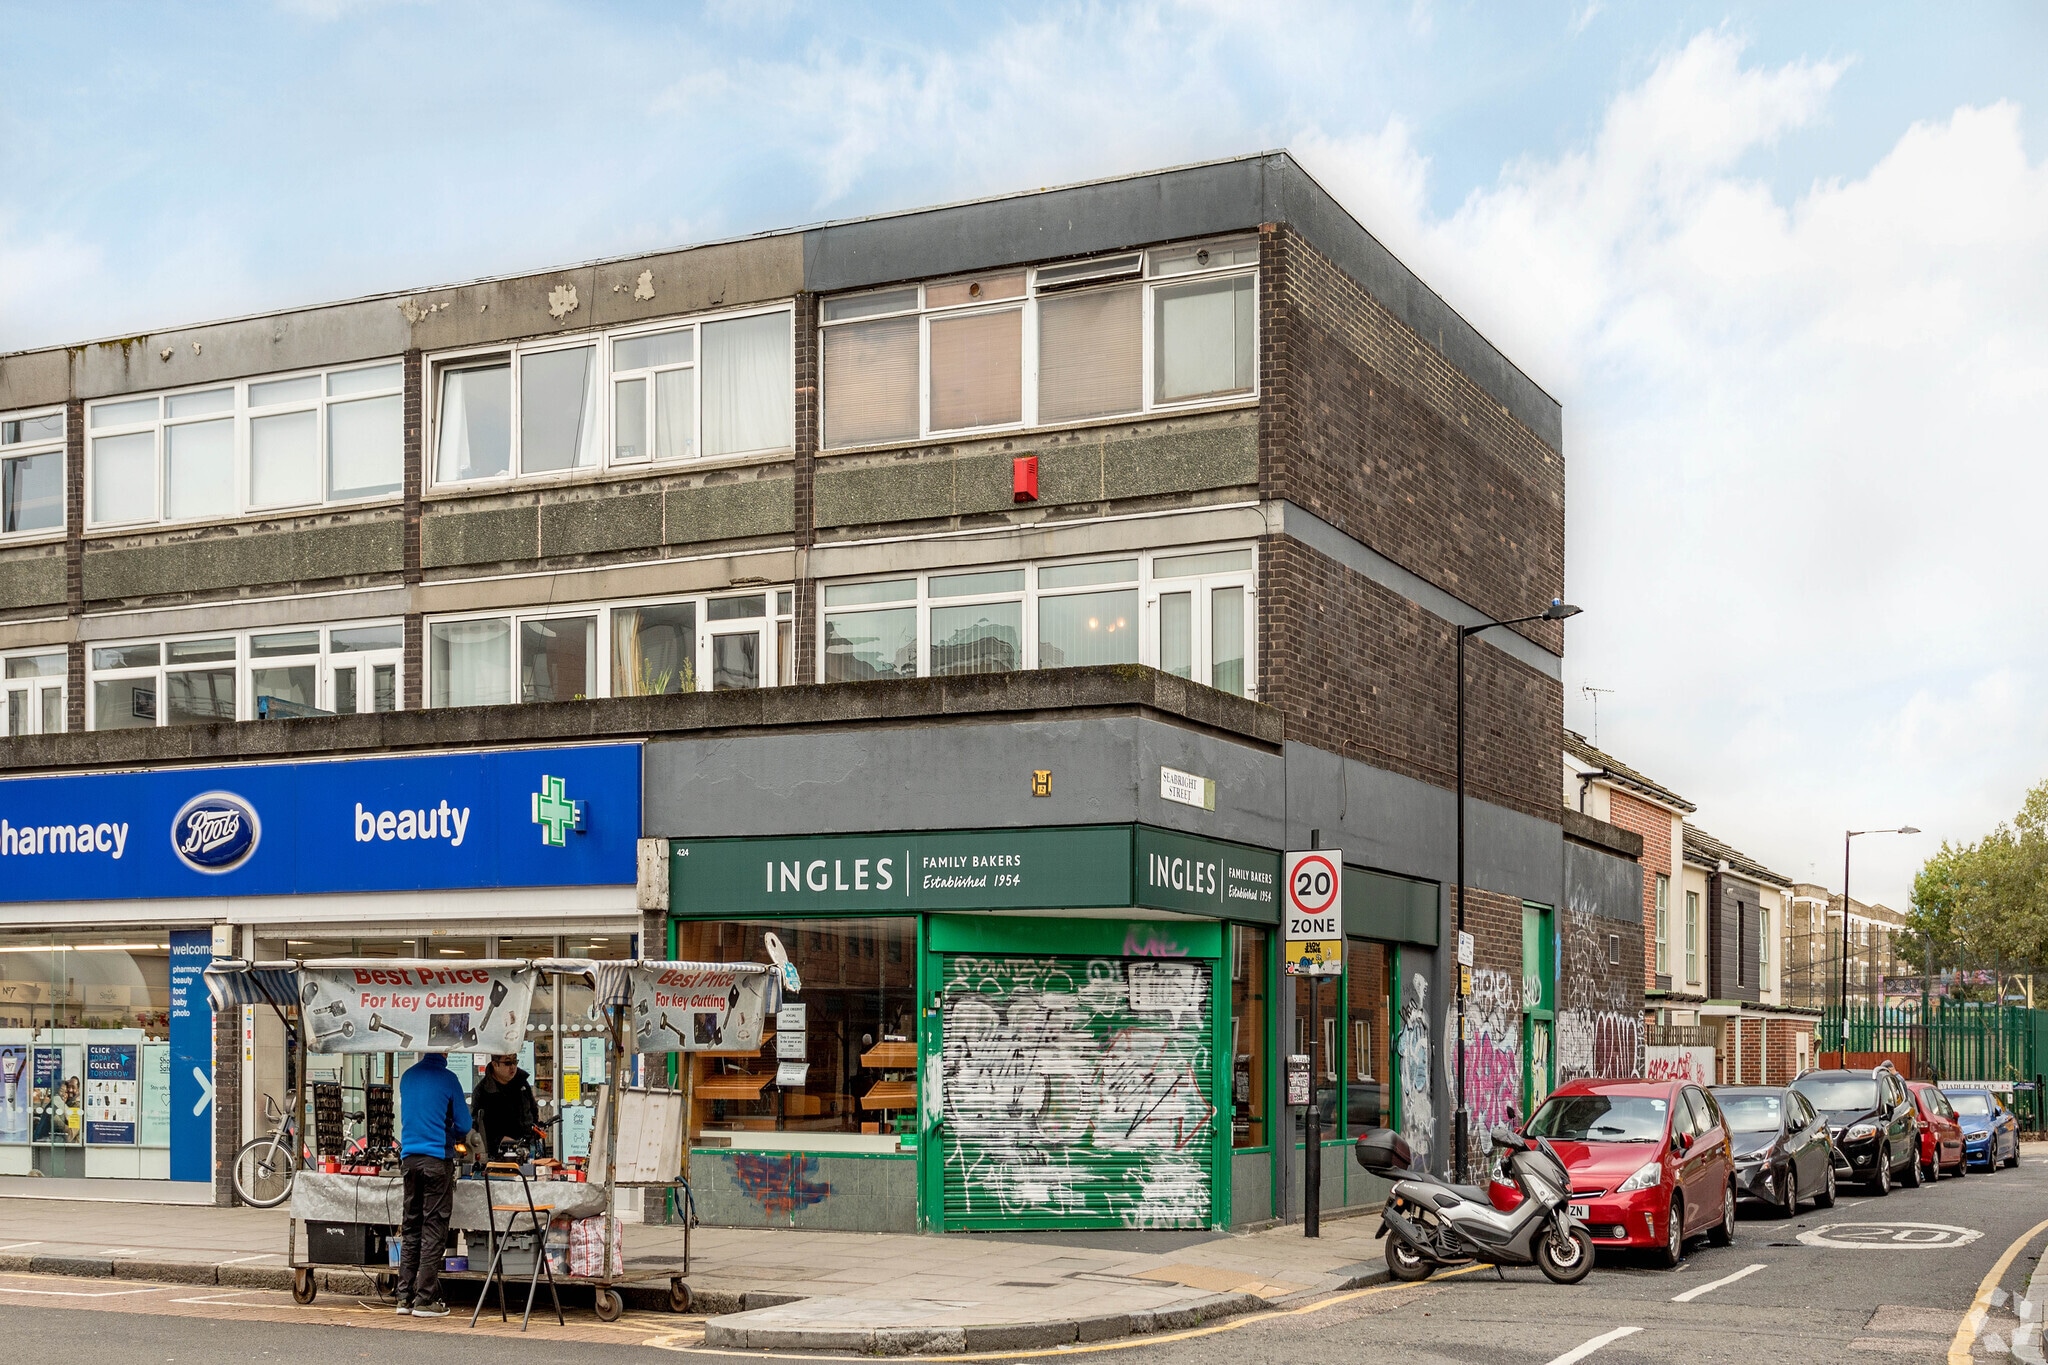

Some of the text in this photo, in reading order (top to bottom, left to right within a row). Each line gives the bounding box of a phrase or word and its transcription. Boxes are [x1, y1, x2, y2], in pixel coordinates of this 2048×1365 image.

[1163, 771, 1197, 790] SEABRIGHT
[1169, 786, 1192, 801] STREET
[181, 809, 240, 853] Boots
[355, 800, 470, 846] beauty
[0, 819, 129, 859] harmacy
[676, 848, 689, 857] 424
[923, 854, 1021, 868] FAMILY BAKERS
[766, 857, 893, 893] INGLES
[923, 873, 1021, 889] Established 1954
[1149, 853, 1216, 895] INGLES
[1228, 867, 1273, 885] FAMILY BAKERS
[1297, 872, 1331, 896] 20
[1228, 884, 1272, 903] Established 1954
[1291, 918, 1335, 934] ZONE
[172, 965, 202, 974] pharmacy
[352, 967, 490, 986] Best Price
[172, 976, 193, 985] beauty
[656, 969, 737, 989] Best Price
[172, 987, 186, 995] food
[172, 998, 188, 1007] baby
[360, 991, 485, 1012] For key Cutting
[655, 992, 726, 1011] For key Cutting
[172, 1009, 191, 1018] photo
[90, 1062, 120, 1070] COLLECT
[1831, 1227, 1951, 1242] 20
